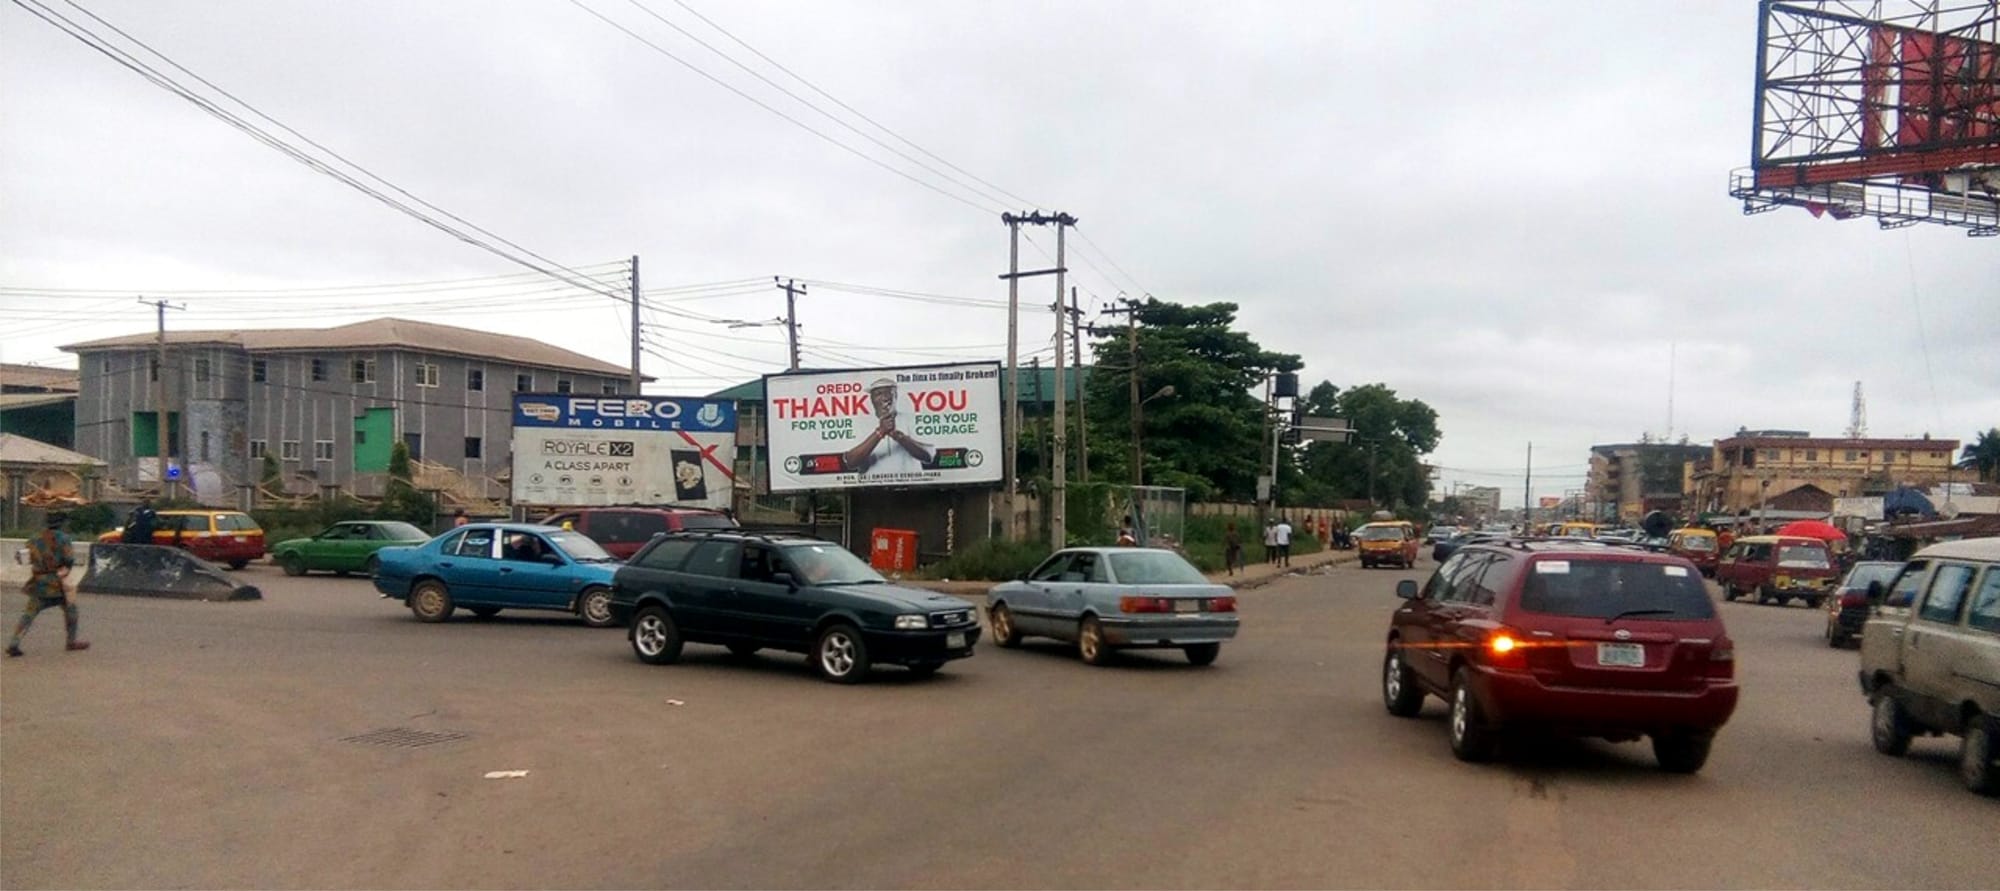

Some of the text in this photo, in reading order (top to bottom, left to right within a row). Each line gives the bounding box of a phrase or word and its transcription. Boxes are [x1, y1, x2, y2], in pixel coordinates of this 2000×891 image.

[929, 372, 937, 382] is
[816, 382, 863, 395] OREDO
[568, 398, 682, 419] FERO
[772, 389, 968, 420] THANK YOU
[568, 418, 682, 429] MOBILE
[791, 418, 854, 431] FOR YOUR
[914, 412, 978, 426] FOR YOUR
[821, 429, 857, 441] LOVE.
[915, 423, 979, 437] COURAGE.
[544, 440, 632, 456] ROYALE X2
[544, 460, 631, 472] A CLASS APART
